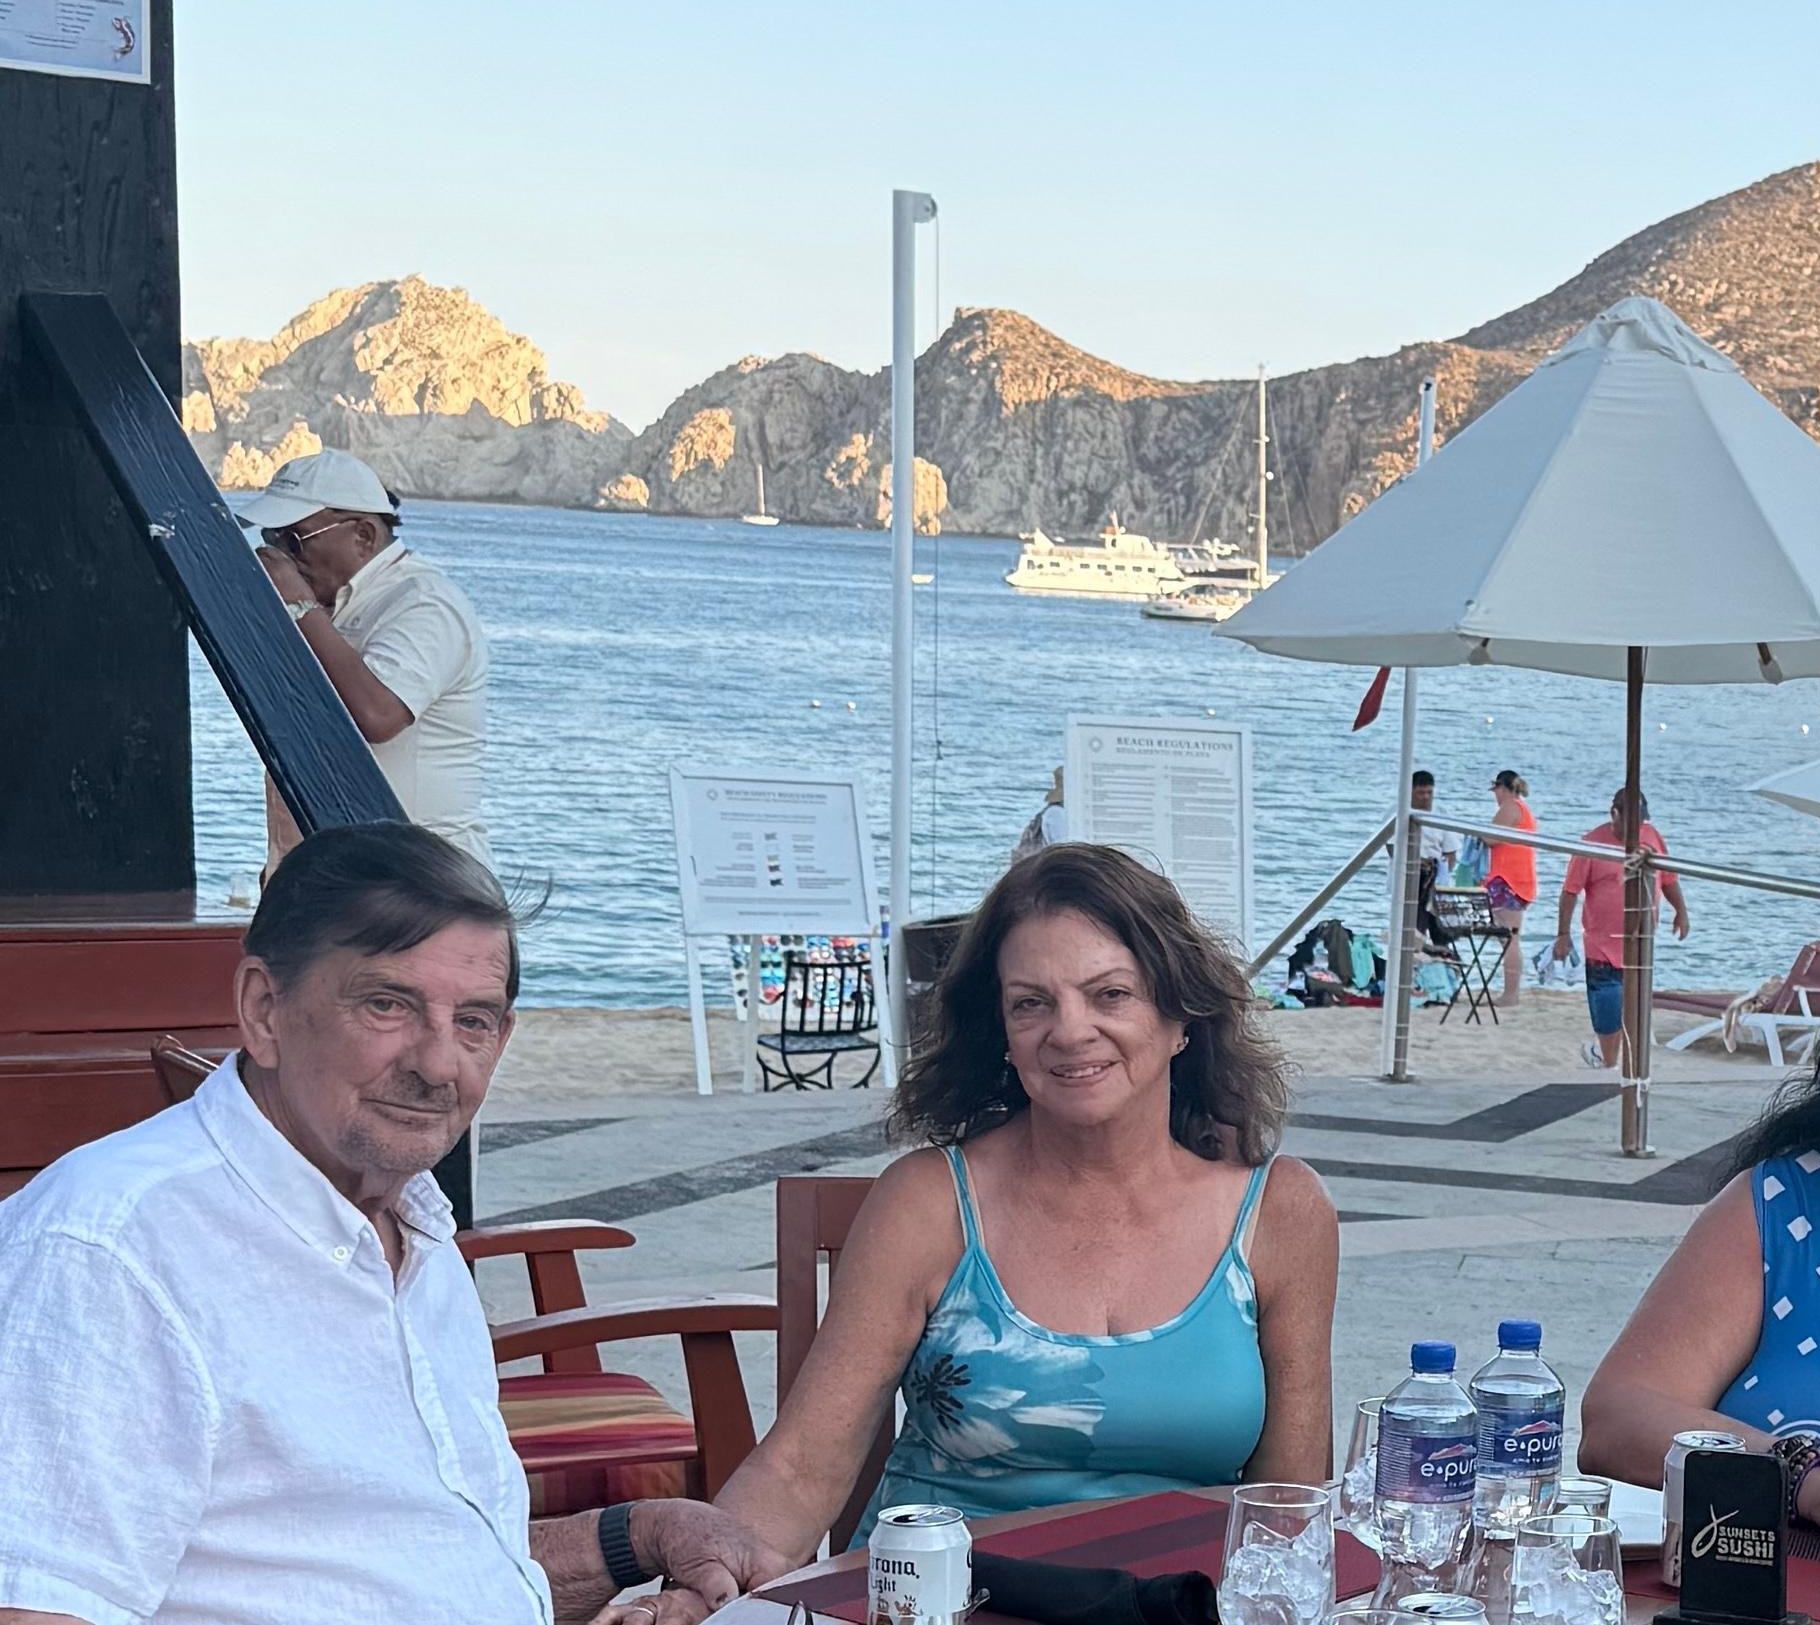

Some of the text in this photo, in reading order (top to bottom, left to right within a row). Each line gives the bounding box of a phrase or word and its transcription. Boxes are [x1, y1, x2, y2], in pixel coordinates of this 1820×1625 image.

[1117, 737, 1233, 751] BEACH REGULATIONS
[1718, 1526, 1776, 1542] SUNSETS
[1717, 1537, 1774, 1559] SUSHI
